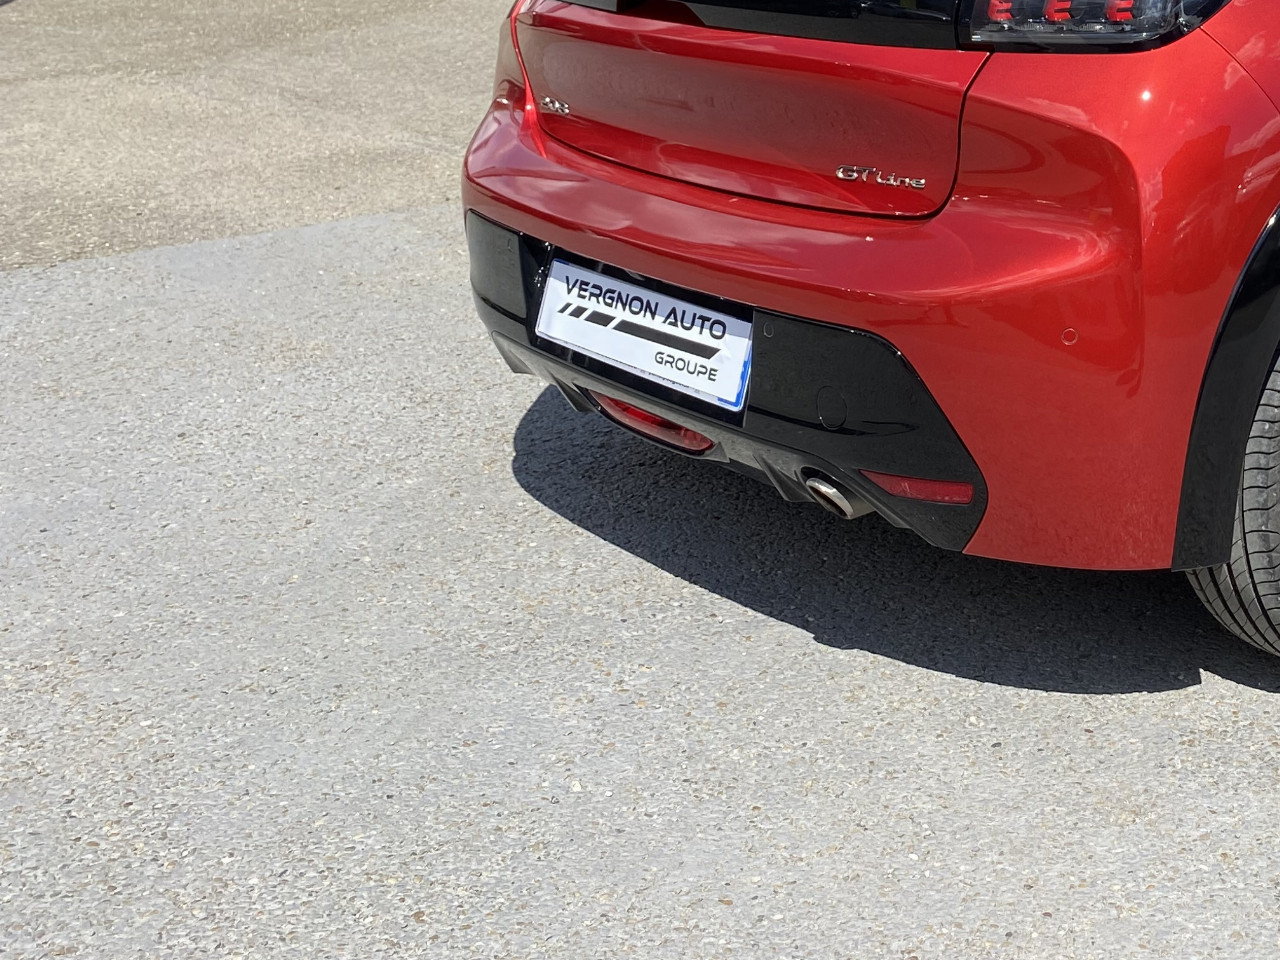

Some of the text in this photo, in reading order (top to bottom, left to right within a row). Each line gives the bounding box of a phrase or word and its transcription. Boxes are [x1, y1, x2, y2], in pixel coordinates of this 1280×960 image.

[564, 275, 727, 340] VERGNON AUTO
[654, 351, 719, 381] GROUPE
